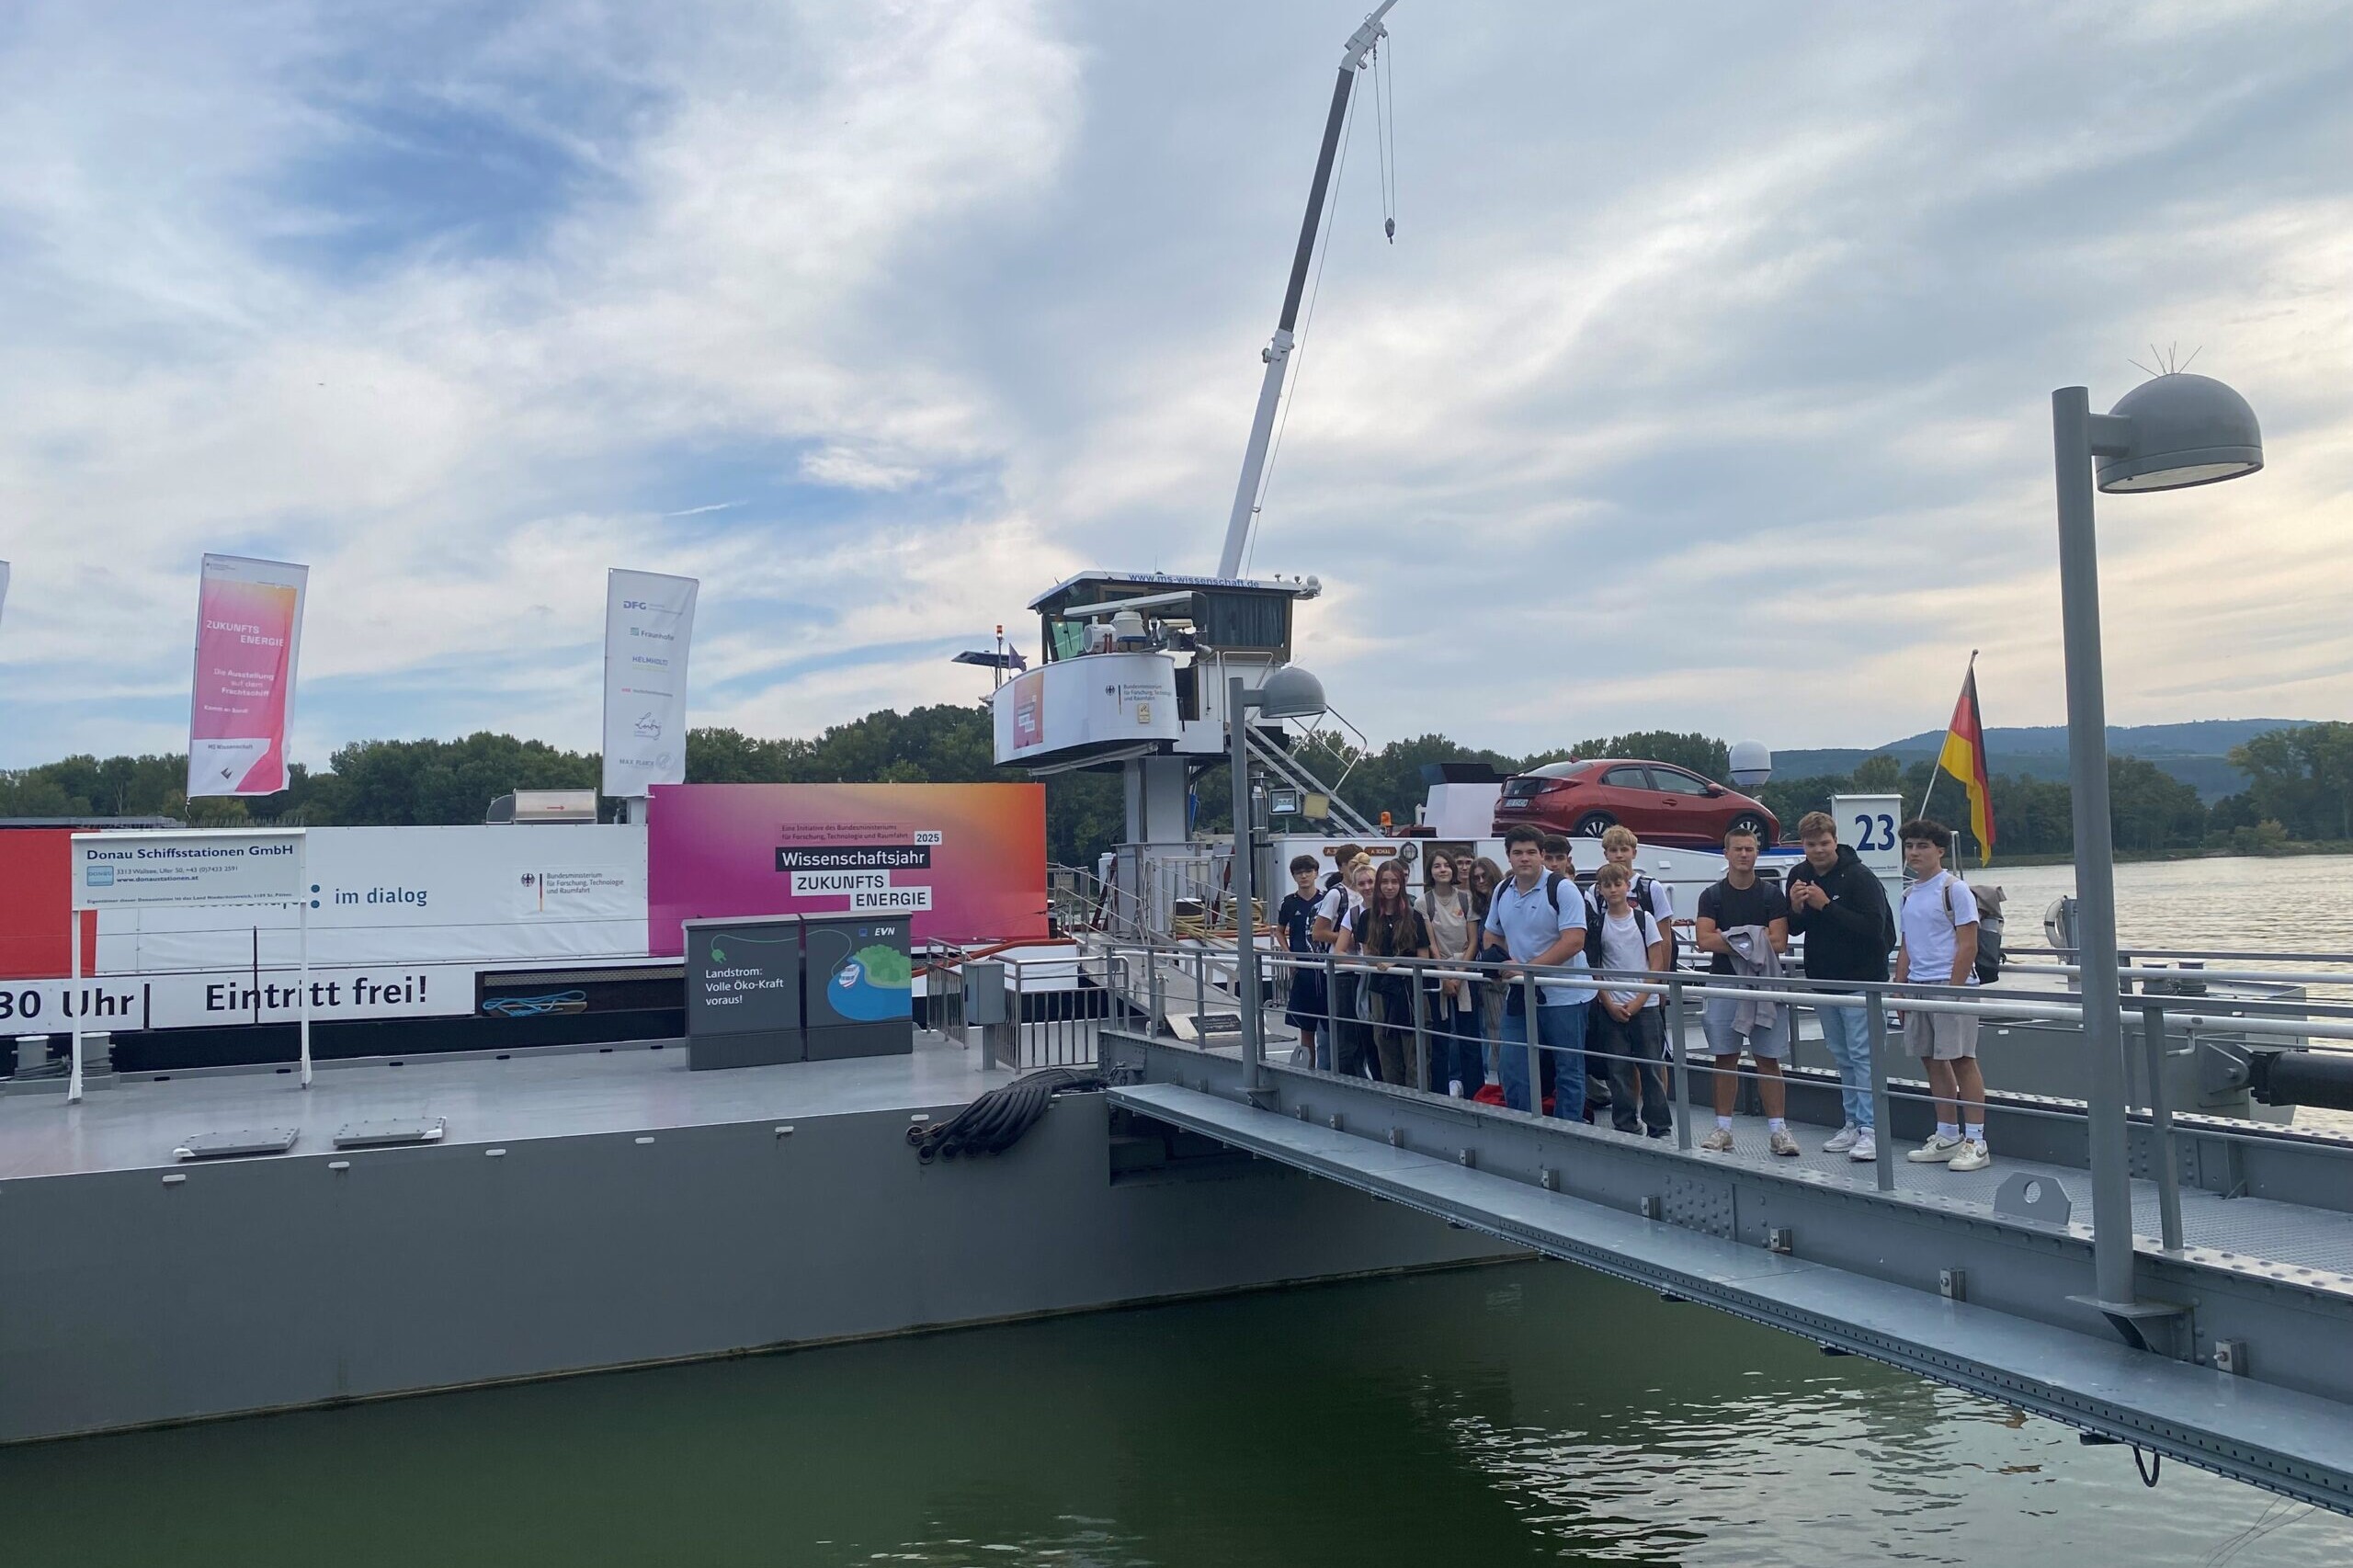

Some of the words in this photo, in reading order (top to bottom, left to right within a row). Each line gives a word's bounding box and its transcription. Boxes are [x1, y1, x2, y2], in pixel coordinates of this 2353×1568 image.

[1128, 574, 1260, 588] www.ms-wissenschaft.de
[623, 600, 647, 610] DFG
[206, 620, 259, 634] ZUKUNFTS
[240, 635, 284, 646] ENERGIE
[227, 669, 274, 681] Ausstellung
[222, 687, 269, 697] Frachtschiff
[792, 833, 825, 841] Forschung,
[916, 834, 939, 843] 2025
[1855, 813, 1895, 851] 23
[86, 850, 133, 859] Donau
[137, 846, 244, 859] Schiffsstationen
[248, 845, 293, 856] GmbH
[782, 850, 925, 867] Wissenschaftsjahr
[797, 875, 884, 890] ZUKUNFTS
[335, 888, 358, 904] im
[367, 886, 427, 907] dialog
[856, 892, 926, 906] ENERGIE
[874, 927, 895, 936] EVN
[705, 967, 763, 979] Landstrom:
[352, 975, 426, 1006] frei!
[705, 982, 731, 992] Volle
[733, 979, 784, 991] Öko-Kraft
[63, 987, 134, 1017] Uhr
[705, 994, 743, 1006] voraus!
